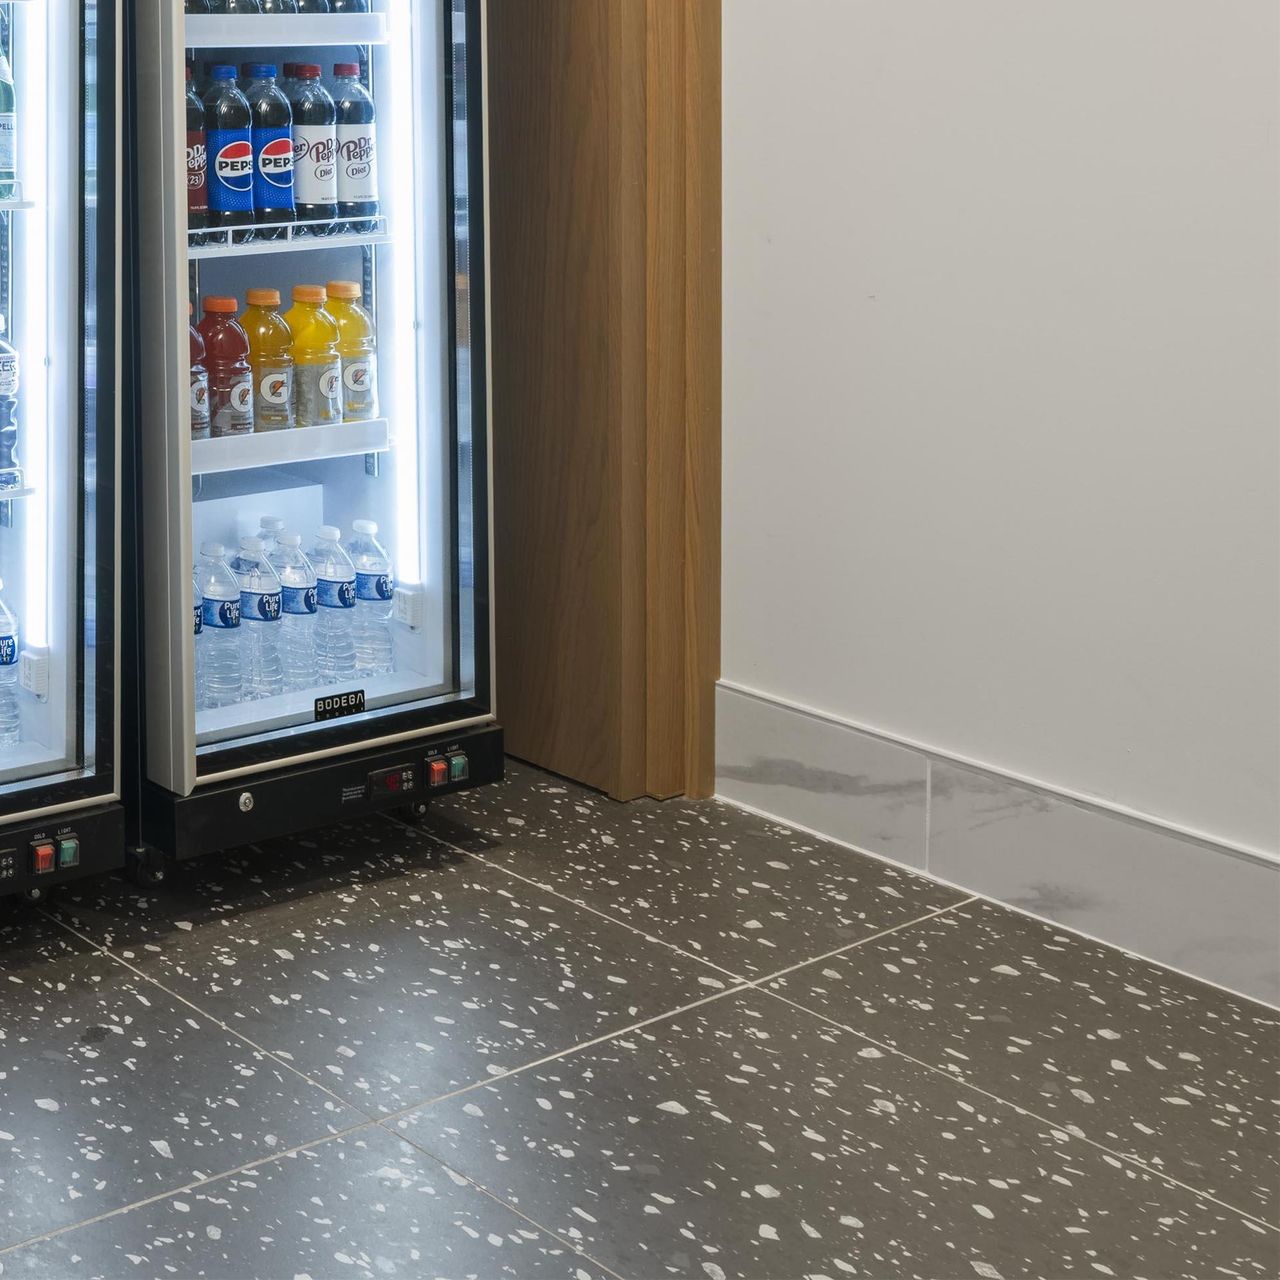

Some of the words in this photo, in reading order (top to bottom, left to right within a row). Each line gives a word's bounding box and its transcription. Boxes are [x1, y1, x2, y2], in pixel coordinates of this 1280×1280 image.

[358, 137, 371, 149] Dr
[320, 167, 332, 177] Diet
[351, 164, 366, 176] Diet
[189, 176, 199, 184] 23
[343, 582, 356, 591] Pure
[345, 589, 355, 598] Life
[263, 595, 279, 604] Pure
[225, 602, 240, 610] Pure
[265, 602, 278, 612] Life
[226, 609, 240, 618] Life
[317, 693, 364, 711] BODEGA
